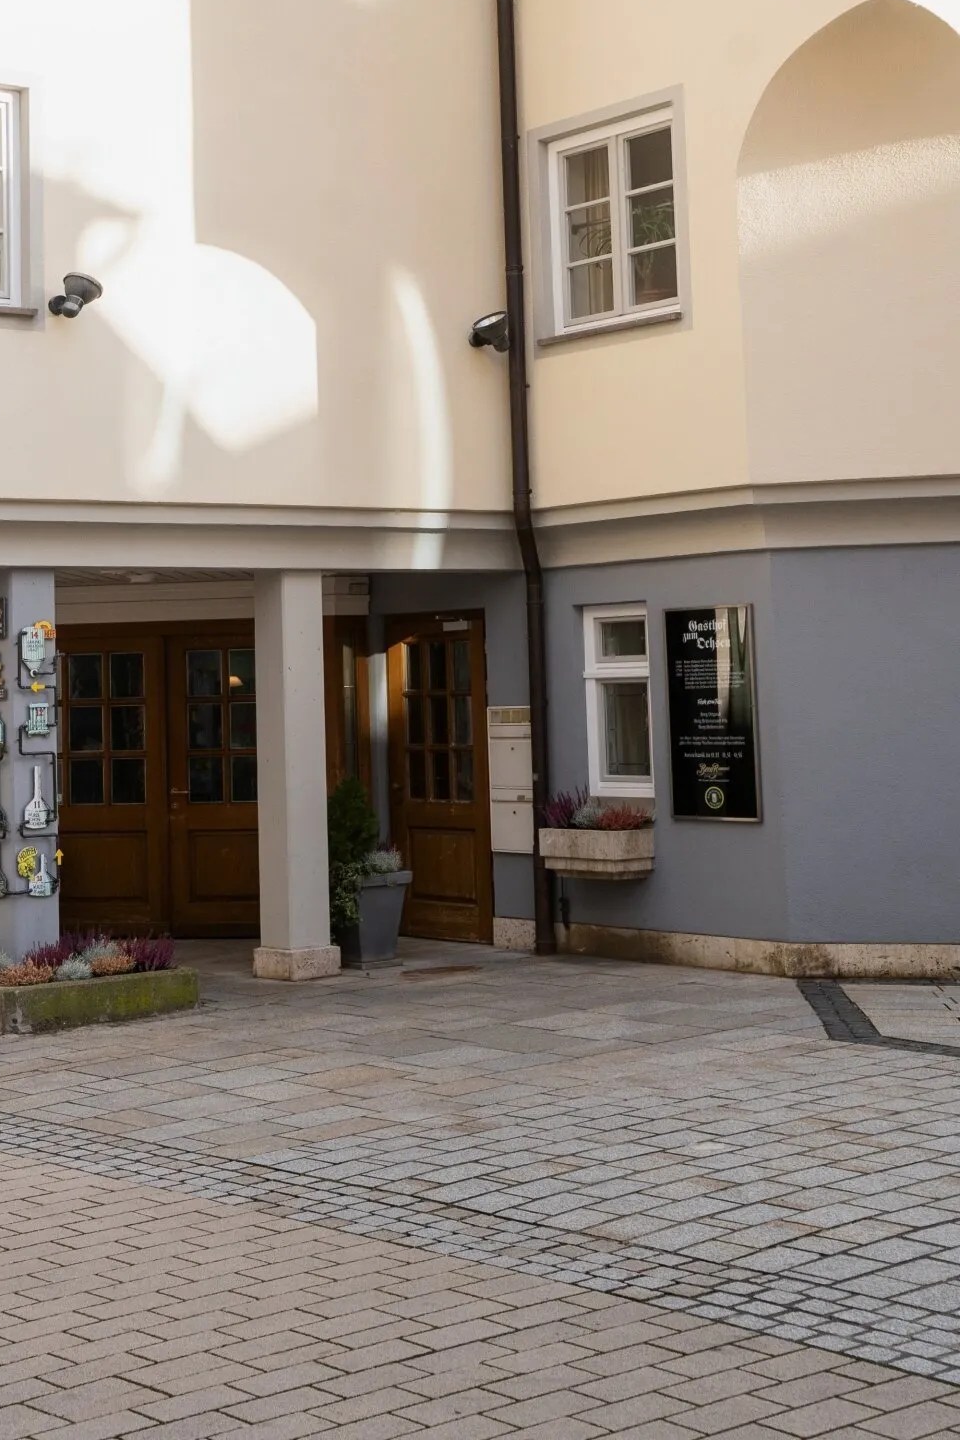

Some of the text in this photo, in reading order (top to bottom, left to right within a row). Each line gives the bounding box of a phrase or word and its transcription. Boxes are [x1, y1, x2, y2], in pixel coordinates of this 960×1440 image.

[688, 618, 726, 632] Gasthof
[682, 632, 698, 643] zum
[696, 637, 730, 651] Ochsen
